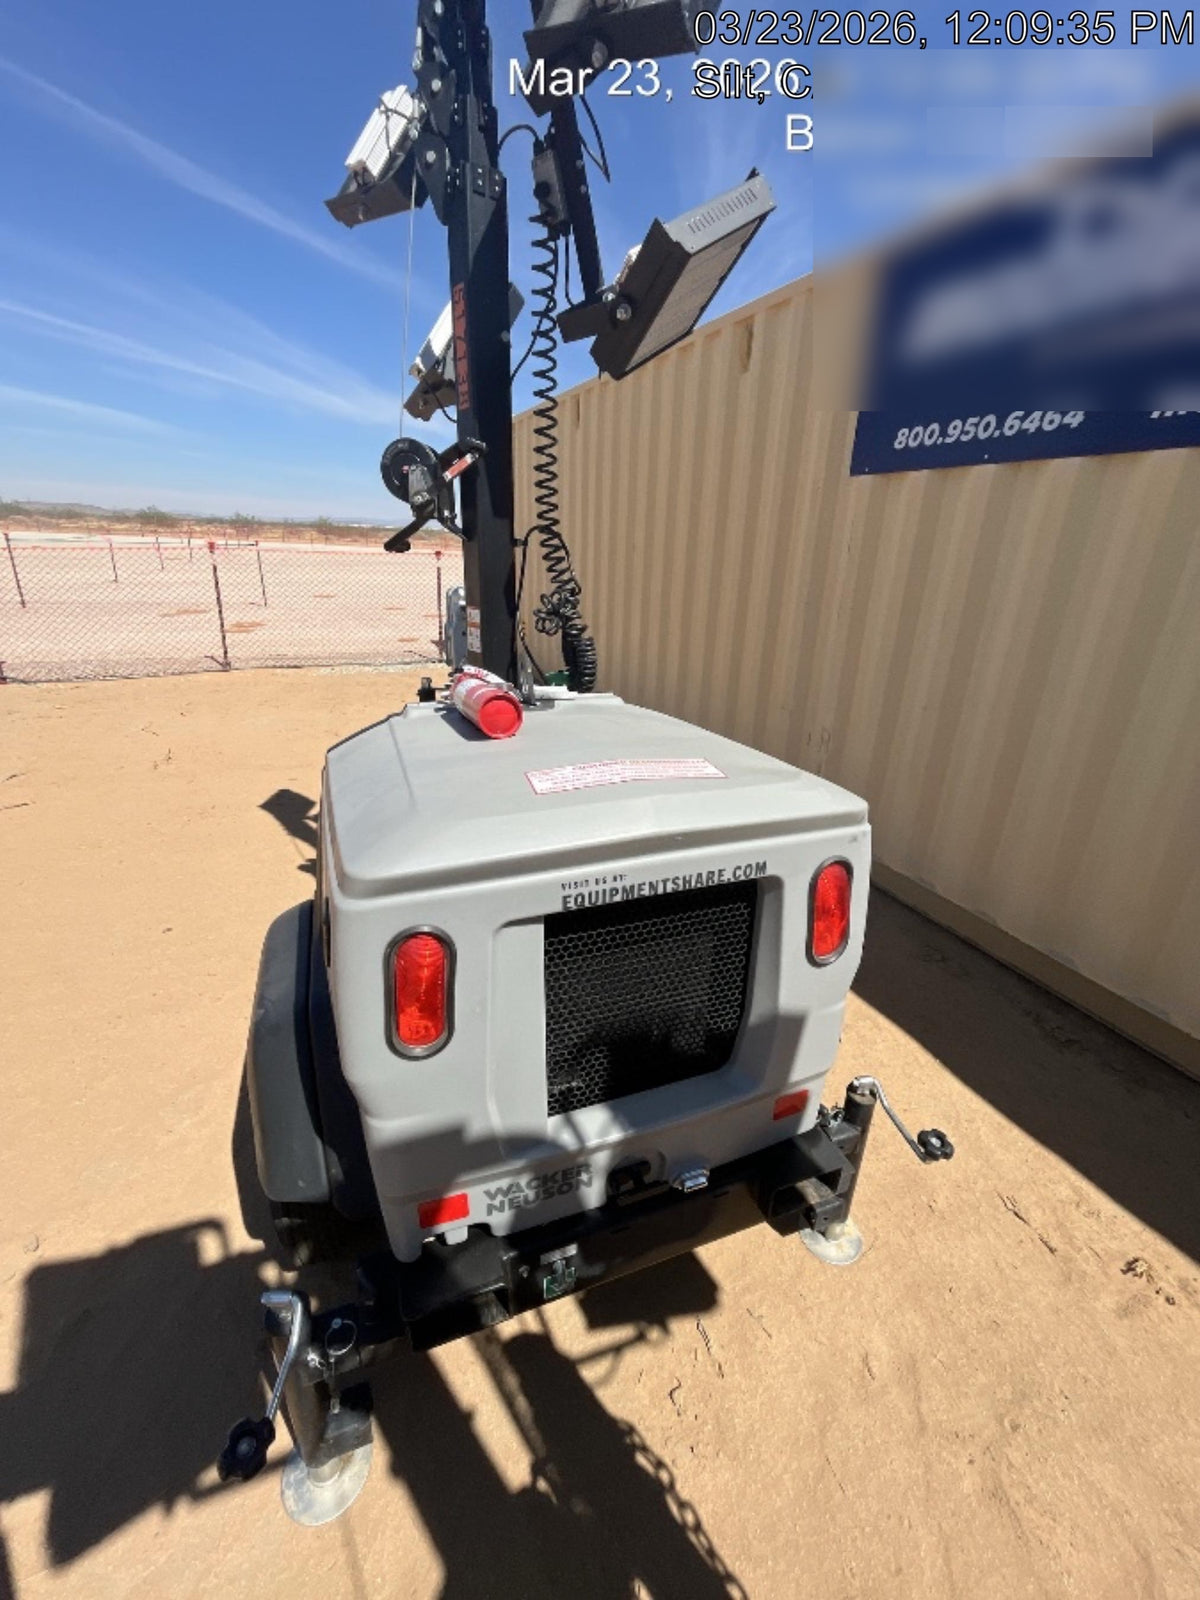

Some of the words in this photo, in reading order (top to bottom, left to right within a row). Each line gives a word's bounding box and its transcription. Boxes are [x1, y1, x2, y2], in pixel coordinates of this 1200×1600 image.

[893, 411, 1084, 449] 800.950.6464
[561, 861, 767, 911] EQUIPMENTSHARE.COM
[484, 1164, 593, 1201] WACKER
[486, 1177, 593, 1216] NEUSON
